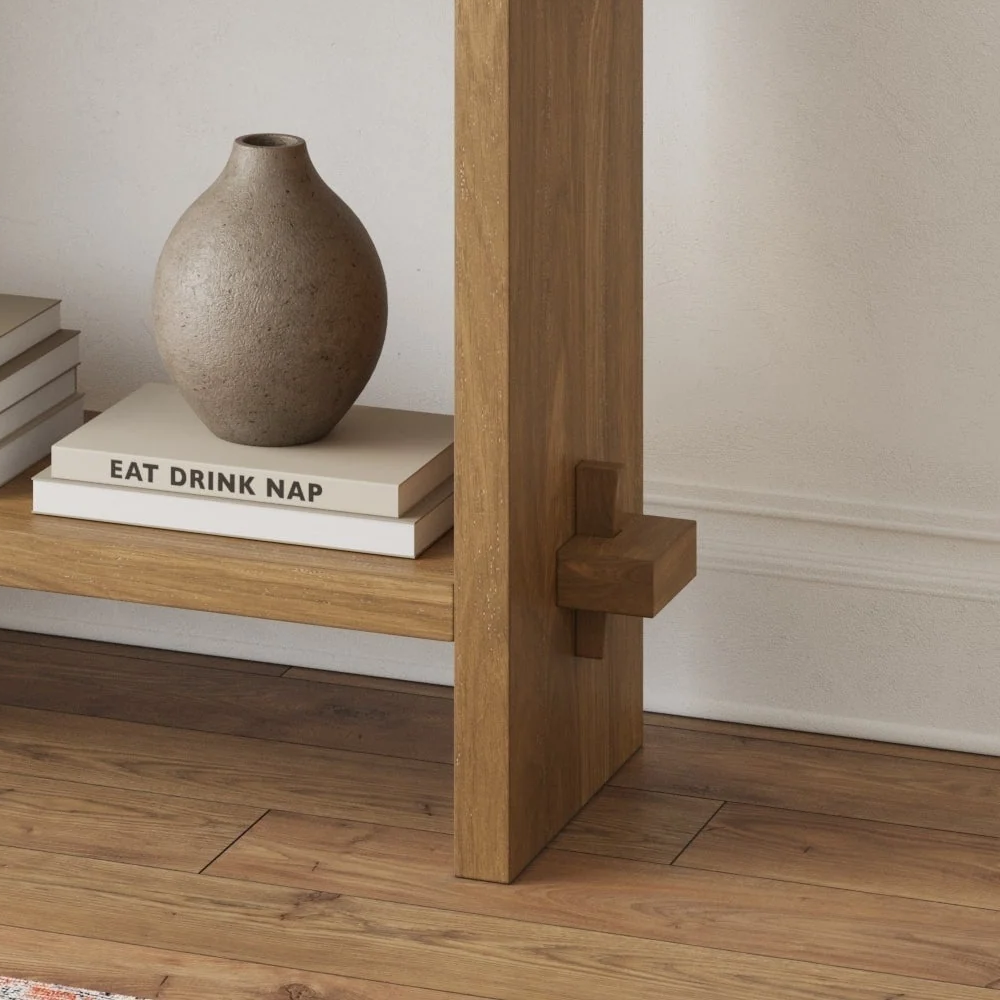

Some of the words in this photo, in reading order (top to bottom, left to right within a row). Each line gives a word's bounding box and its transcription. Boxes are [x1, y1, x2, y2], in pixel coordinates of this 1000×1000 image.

[110, 459, 159, 483] EAT
[170, 466, 257, 496] DRINK
[266, 478, 323, 503] NAP
